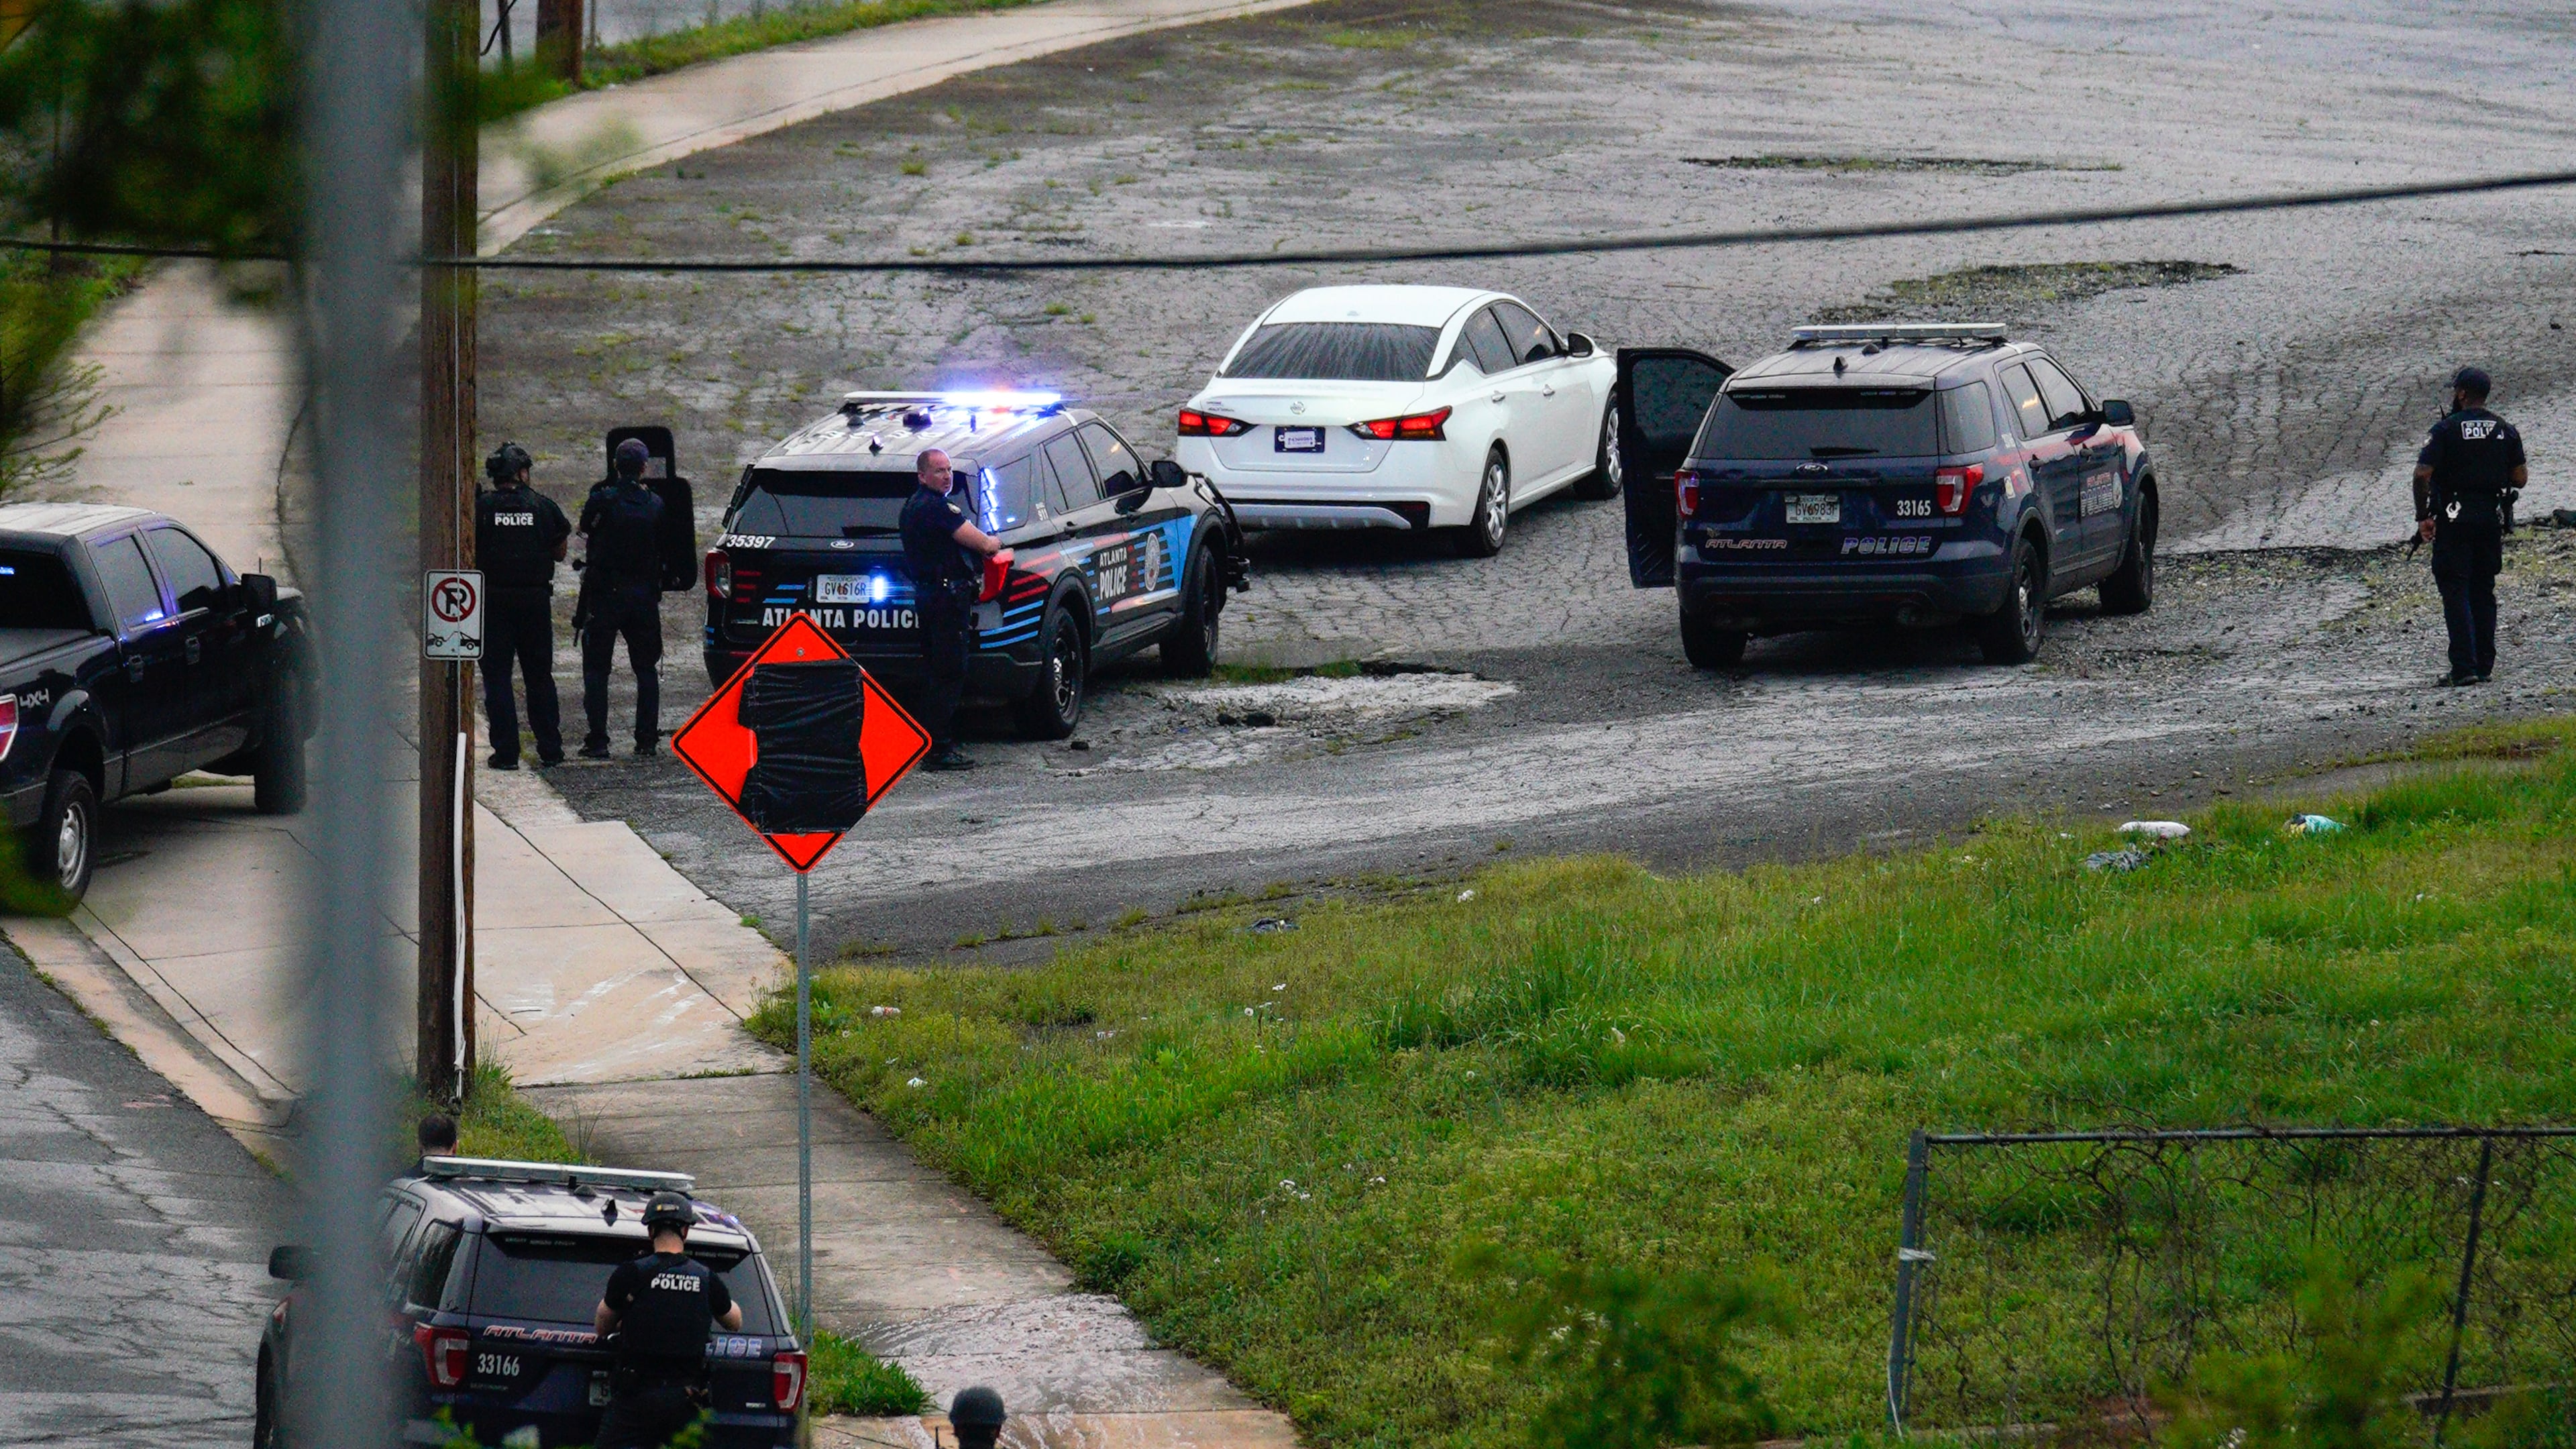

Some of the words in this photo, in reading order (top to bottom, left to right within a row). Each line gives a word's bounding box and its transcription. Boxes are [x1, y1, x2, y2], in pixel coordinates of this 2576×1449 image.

[2465, 427, 2501, 438] POLI
[1897, 500, 1931, 516] 33165
[494, 517, 534, 526] POLICE
[727, 535, 776, 549] 35397
[1705, 539, 1787, 549] ATLANTA
[1841, 536, 1931, 554] POLICE
[1100, 547, 1128, 568] ATLANTA
[1100, 565, 1128, 600] POLICE
[853, 609, 920, 629] POLIC
[651, 1277, 700, 1293] POLICE
[483, 1325, 599, 1344] ATLANTA
[478, 1352, 520, 1377] 33166
